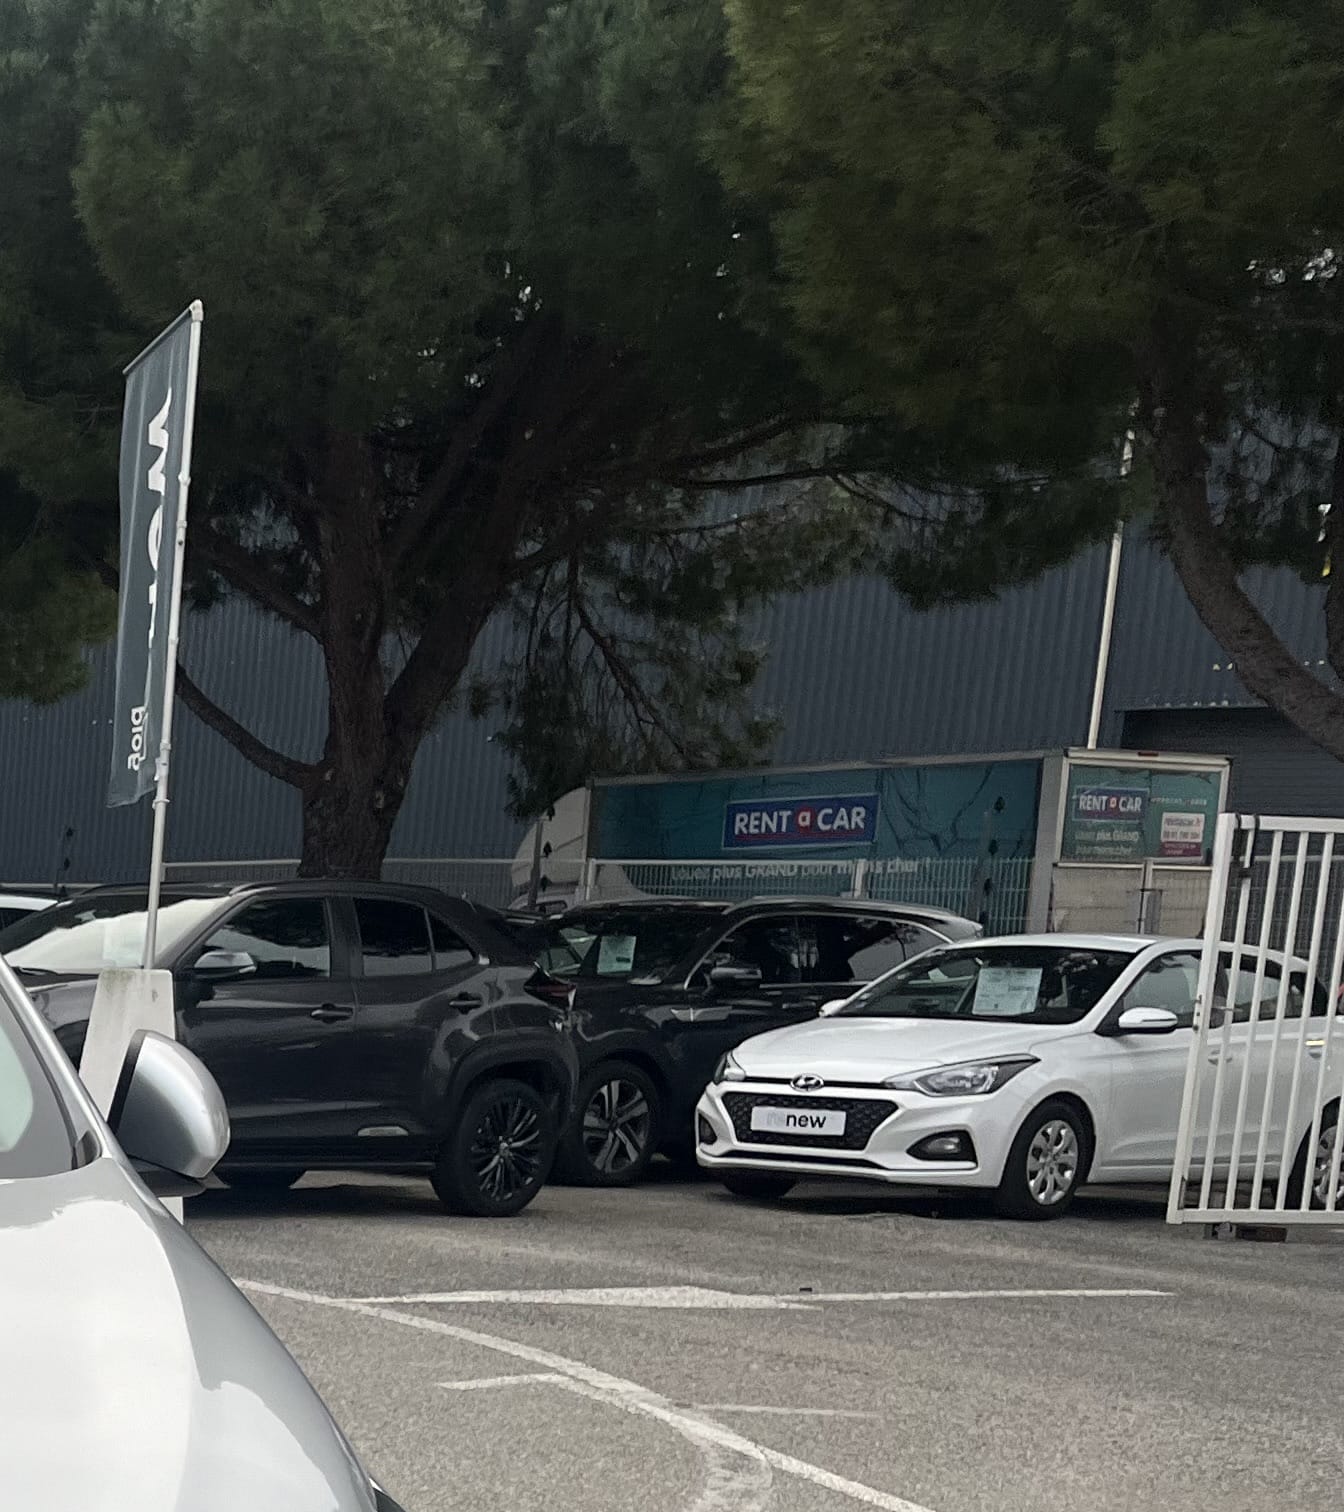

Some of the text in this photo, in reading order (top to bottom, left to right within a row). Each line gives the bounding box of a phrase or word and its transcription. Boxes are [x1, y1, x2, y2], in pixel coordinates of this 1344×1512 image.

[1079, 795, 1108, 811] RENT
[1119, 797, 1142, 812] CAR
[734, 806, 866, 835] RENT a CAR
[745, 862, 798, 878] GRAND
